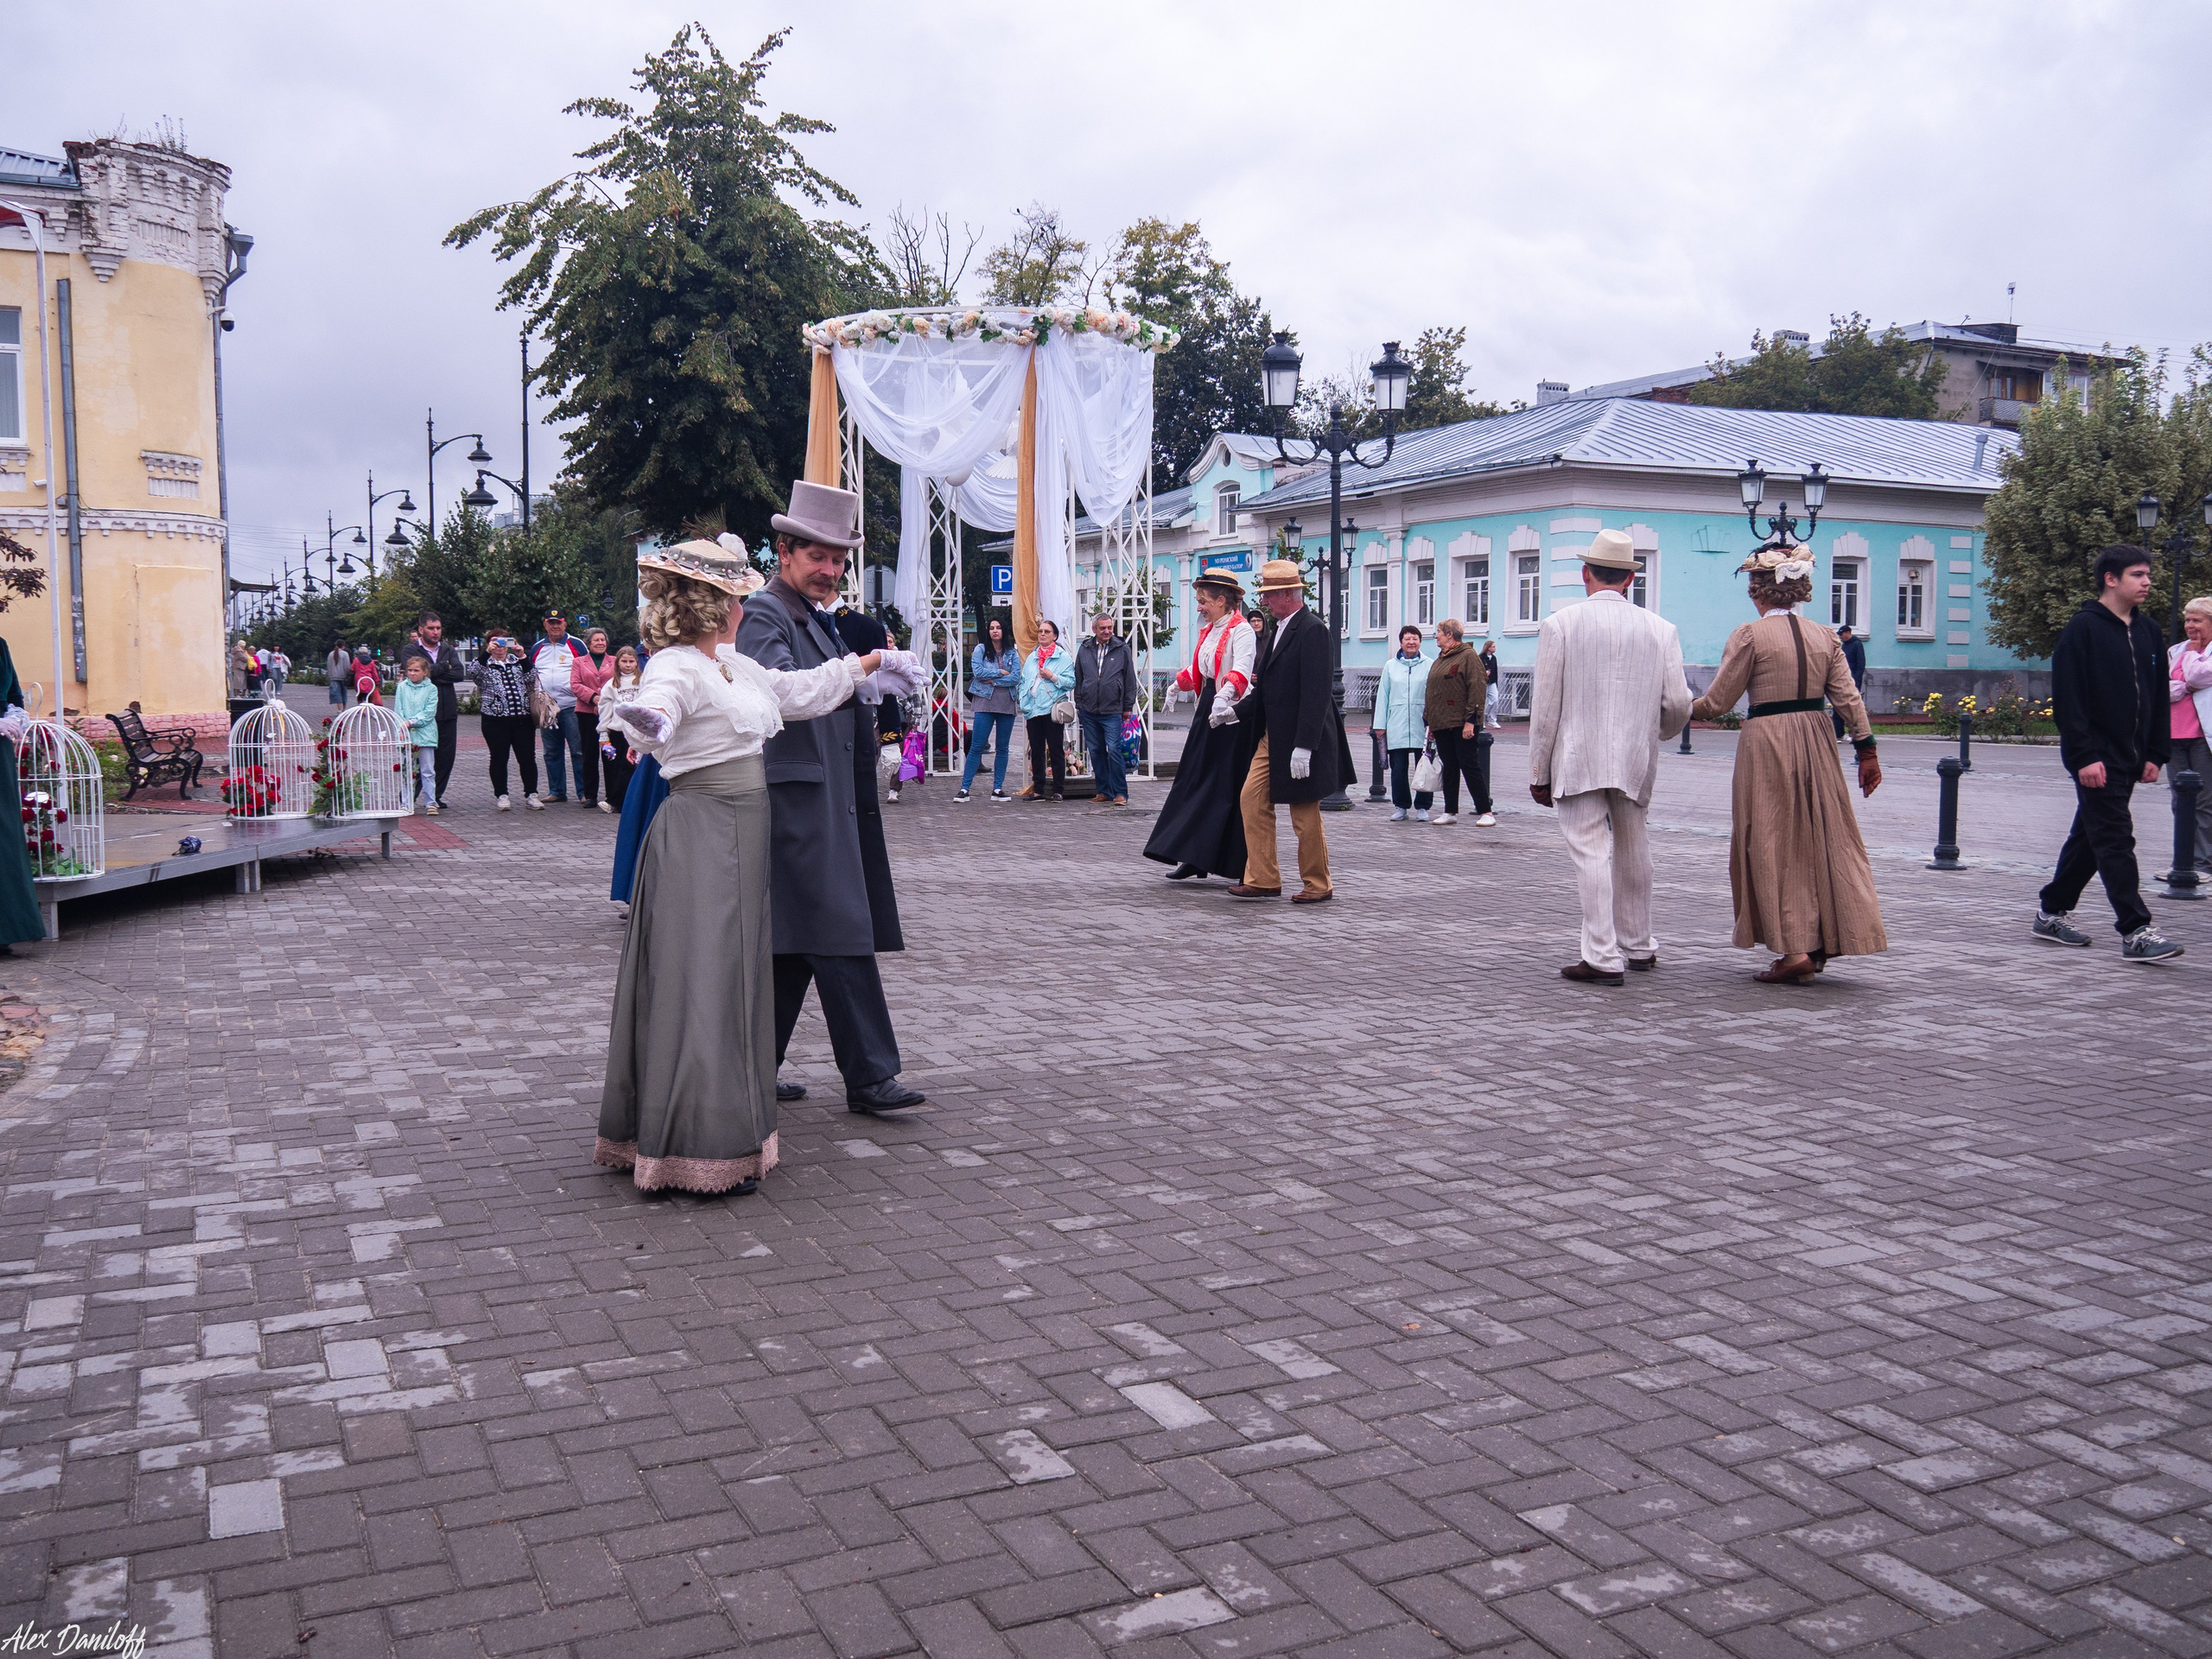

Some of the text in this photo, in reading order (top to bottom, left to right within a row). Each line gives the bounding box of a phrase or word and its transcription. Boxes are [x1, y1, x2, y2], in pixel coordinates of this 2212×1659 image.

[999, 569, 1012, 589] P
[2049, 923, 2063, 935] N
[2135, 940, 2150, 954] N
